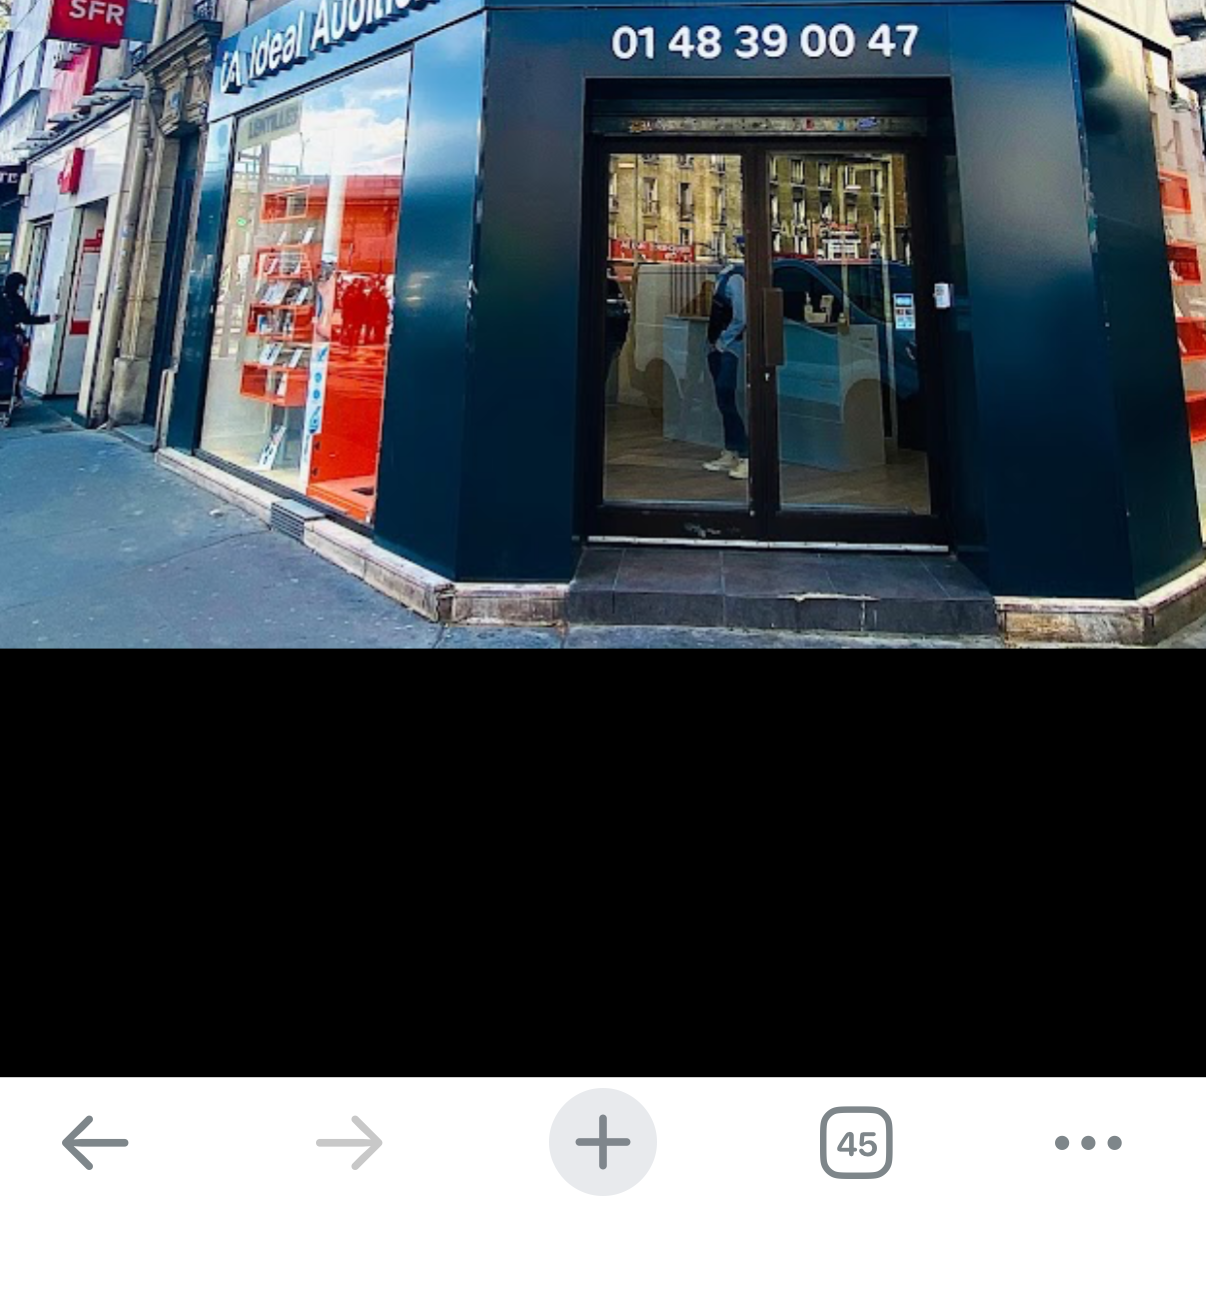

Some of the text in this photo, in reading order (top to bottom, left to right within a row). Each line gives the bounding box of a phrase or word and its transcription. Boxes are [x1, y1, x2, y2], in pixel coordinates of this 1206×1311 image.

[249, 10, 305, 79] Ideal
[612, 23, 919, 59] 01 48 39 00 47
